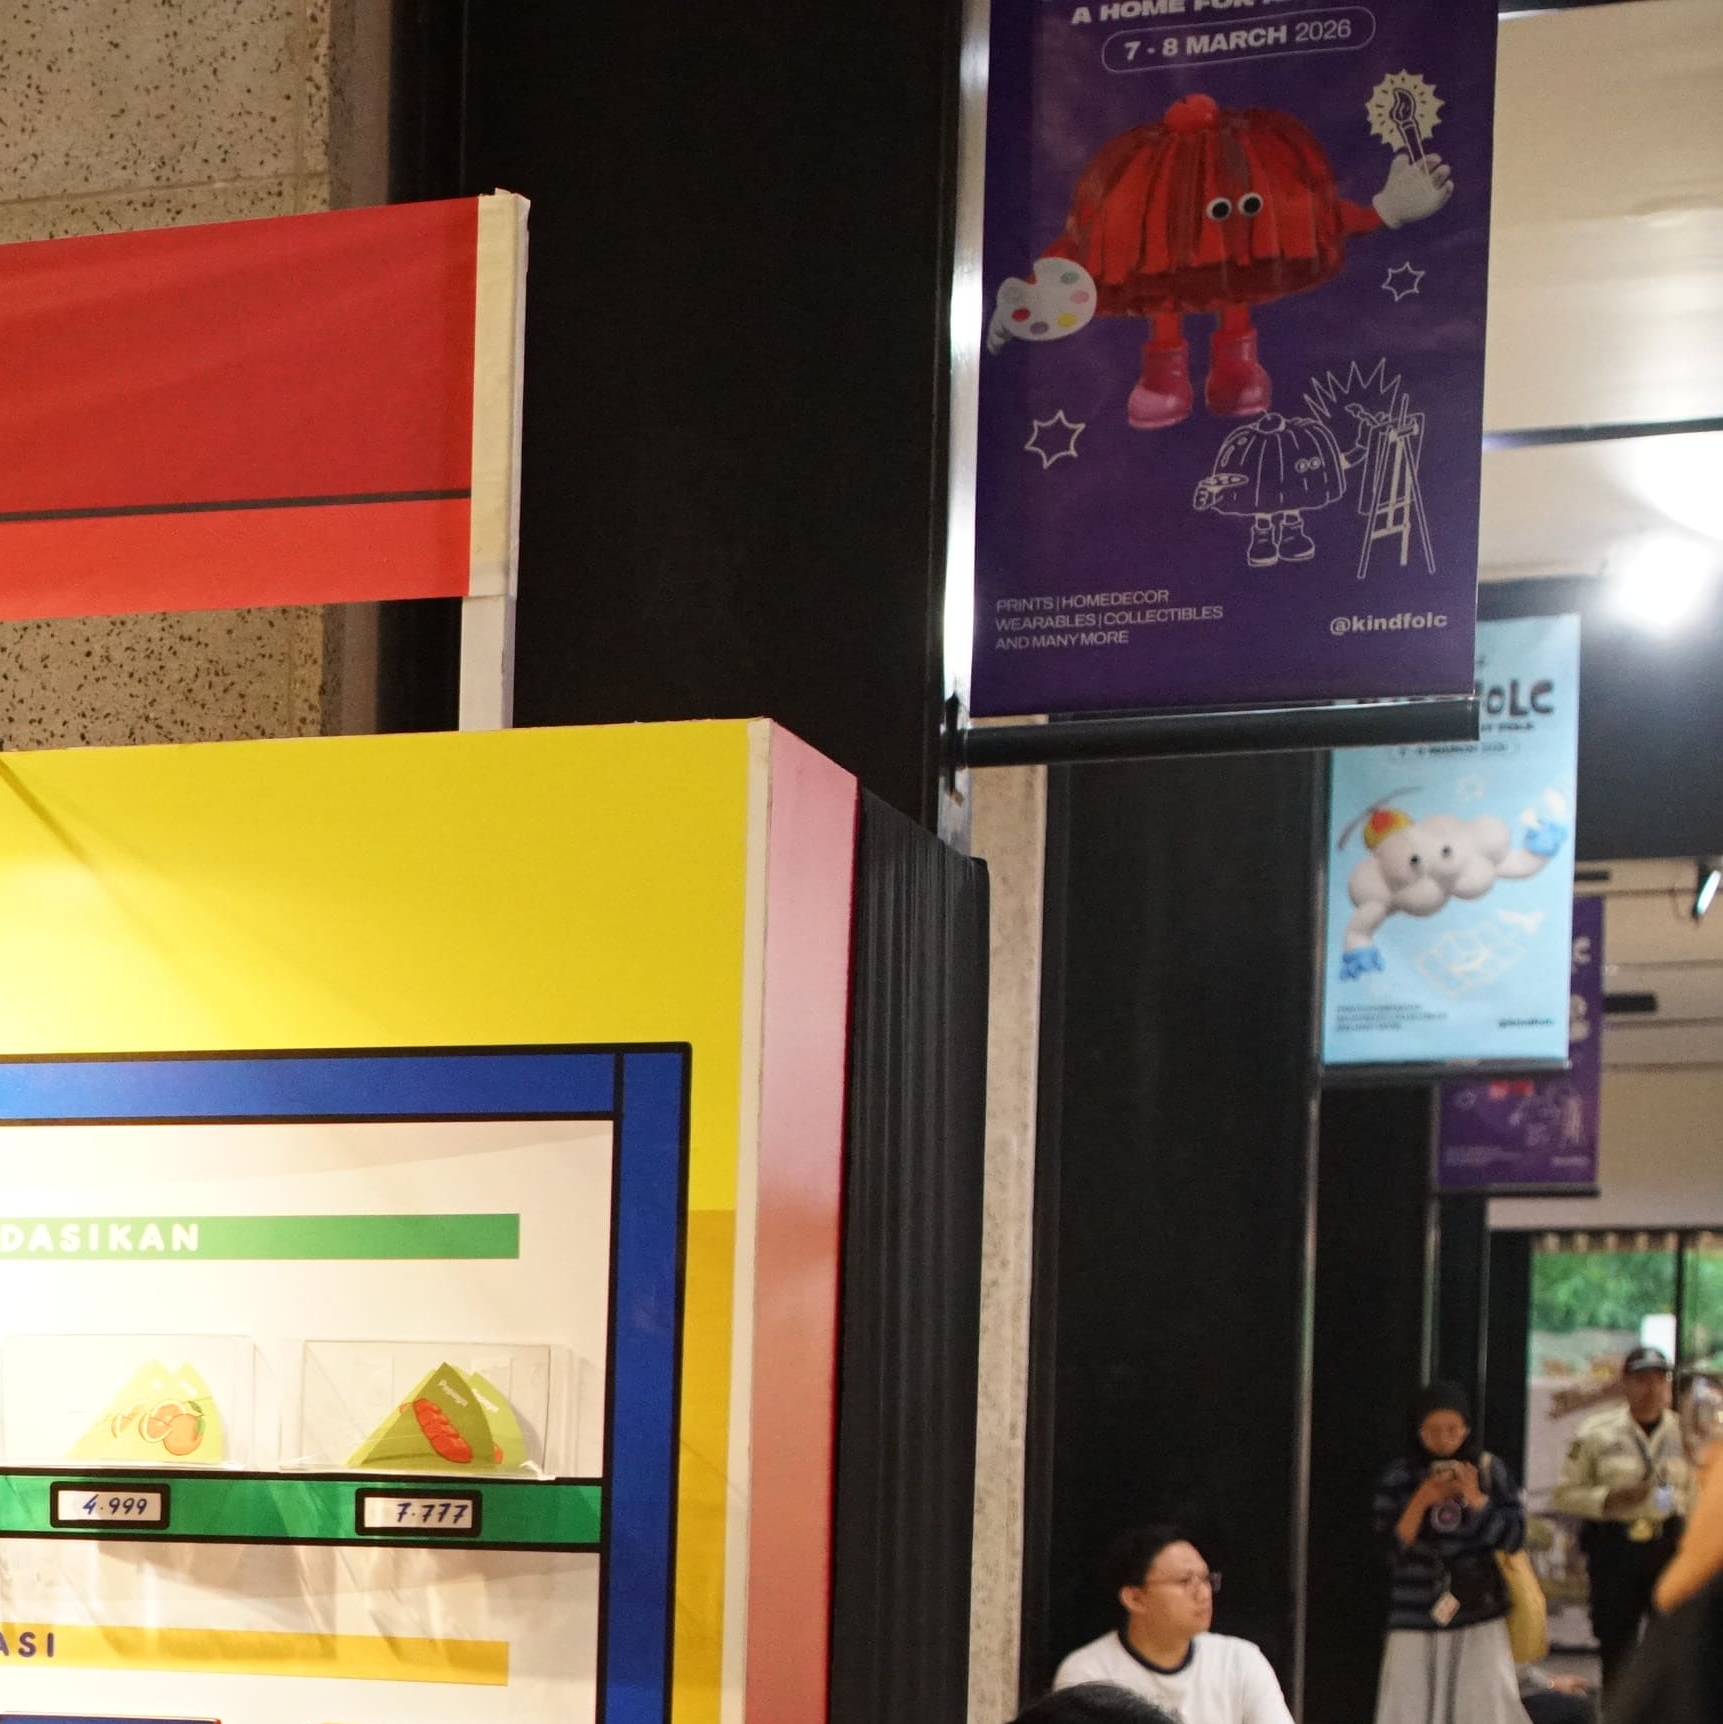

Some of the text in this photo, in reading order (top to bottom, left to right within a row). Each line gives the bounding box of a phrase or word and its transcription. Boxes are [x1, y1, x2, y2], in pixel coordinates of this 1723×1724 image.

[1099, 0, 1186, 21] HOME
[1124, 41, 1141, 61] 7
[1162, 37, 1178, 57] 8
[1186, 25, 1288, 56] MARCH
[1295, 19, 1352, 42] 2026
[996, 596, 1053, 613] PRINTS
[995, 614, 1096, 632] WEARABLES
[1104, 605, 1224, 626] COLLECTIBLES
[1329, 612, 1448, 636] @kindfolc
[995, 630, 1130, 650] AND MANY MORE
[82, 1494, 148, 1515] 4.999
[396, 1502, 469, 1524] 7.777
